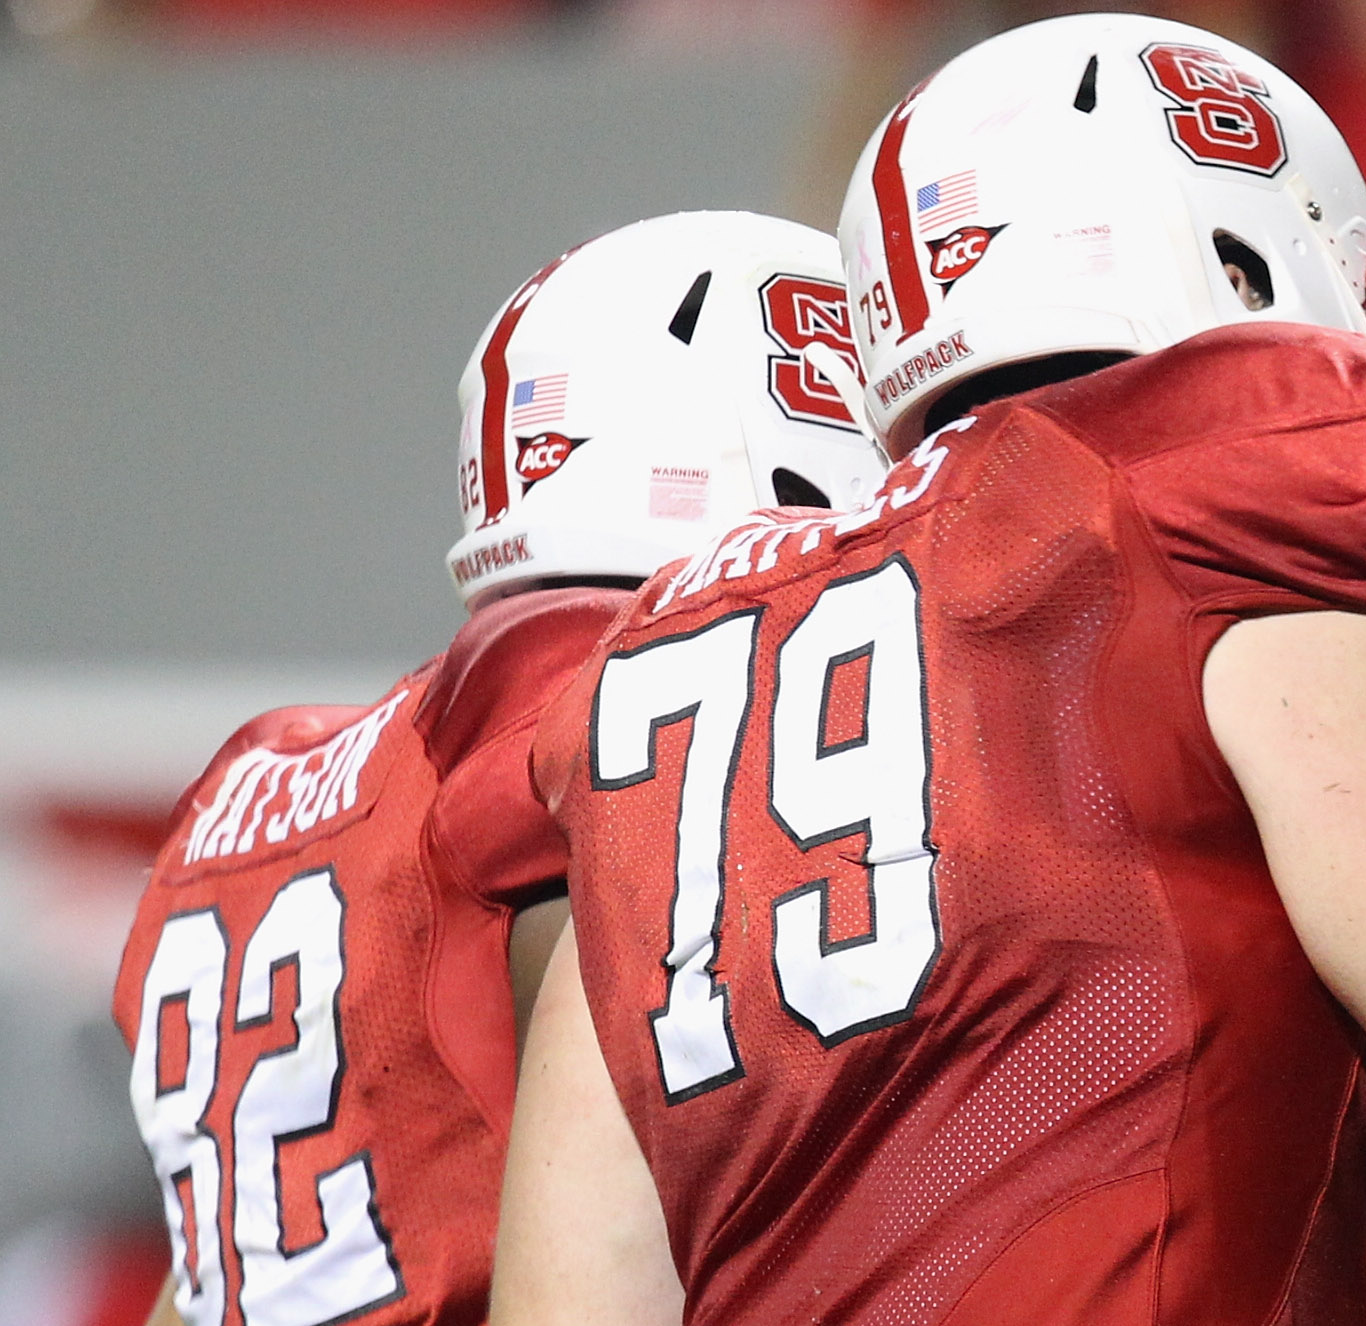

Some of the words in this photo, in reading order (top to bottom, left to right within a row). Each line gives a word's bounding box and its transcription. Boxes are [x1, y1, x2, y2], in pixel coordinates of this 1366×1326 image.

[935, 236, 985, 274] ACC
[1053, 224, 1111, 239] WRNING
[860, 281, 892, 346] 79
[874, 330, 974, 409] WOLFPACK
[520, 444, 565, 472] ACC
[652, 466, 710, 479] WARNING
[459, 458, 481, 514] 82
[451, 533, 534, 585] WOLFPACK
[183, 688, 410, 867] WATSON
[590, 552, 943, 1106] 79
